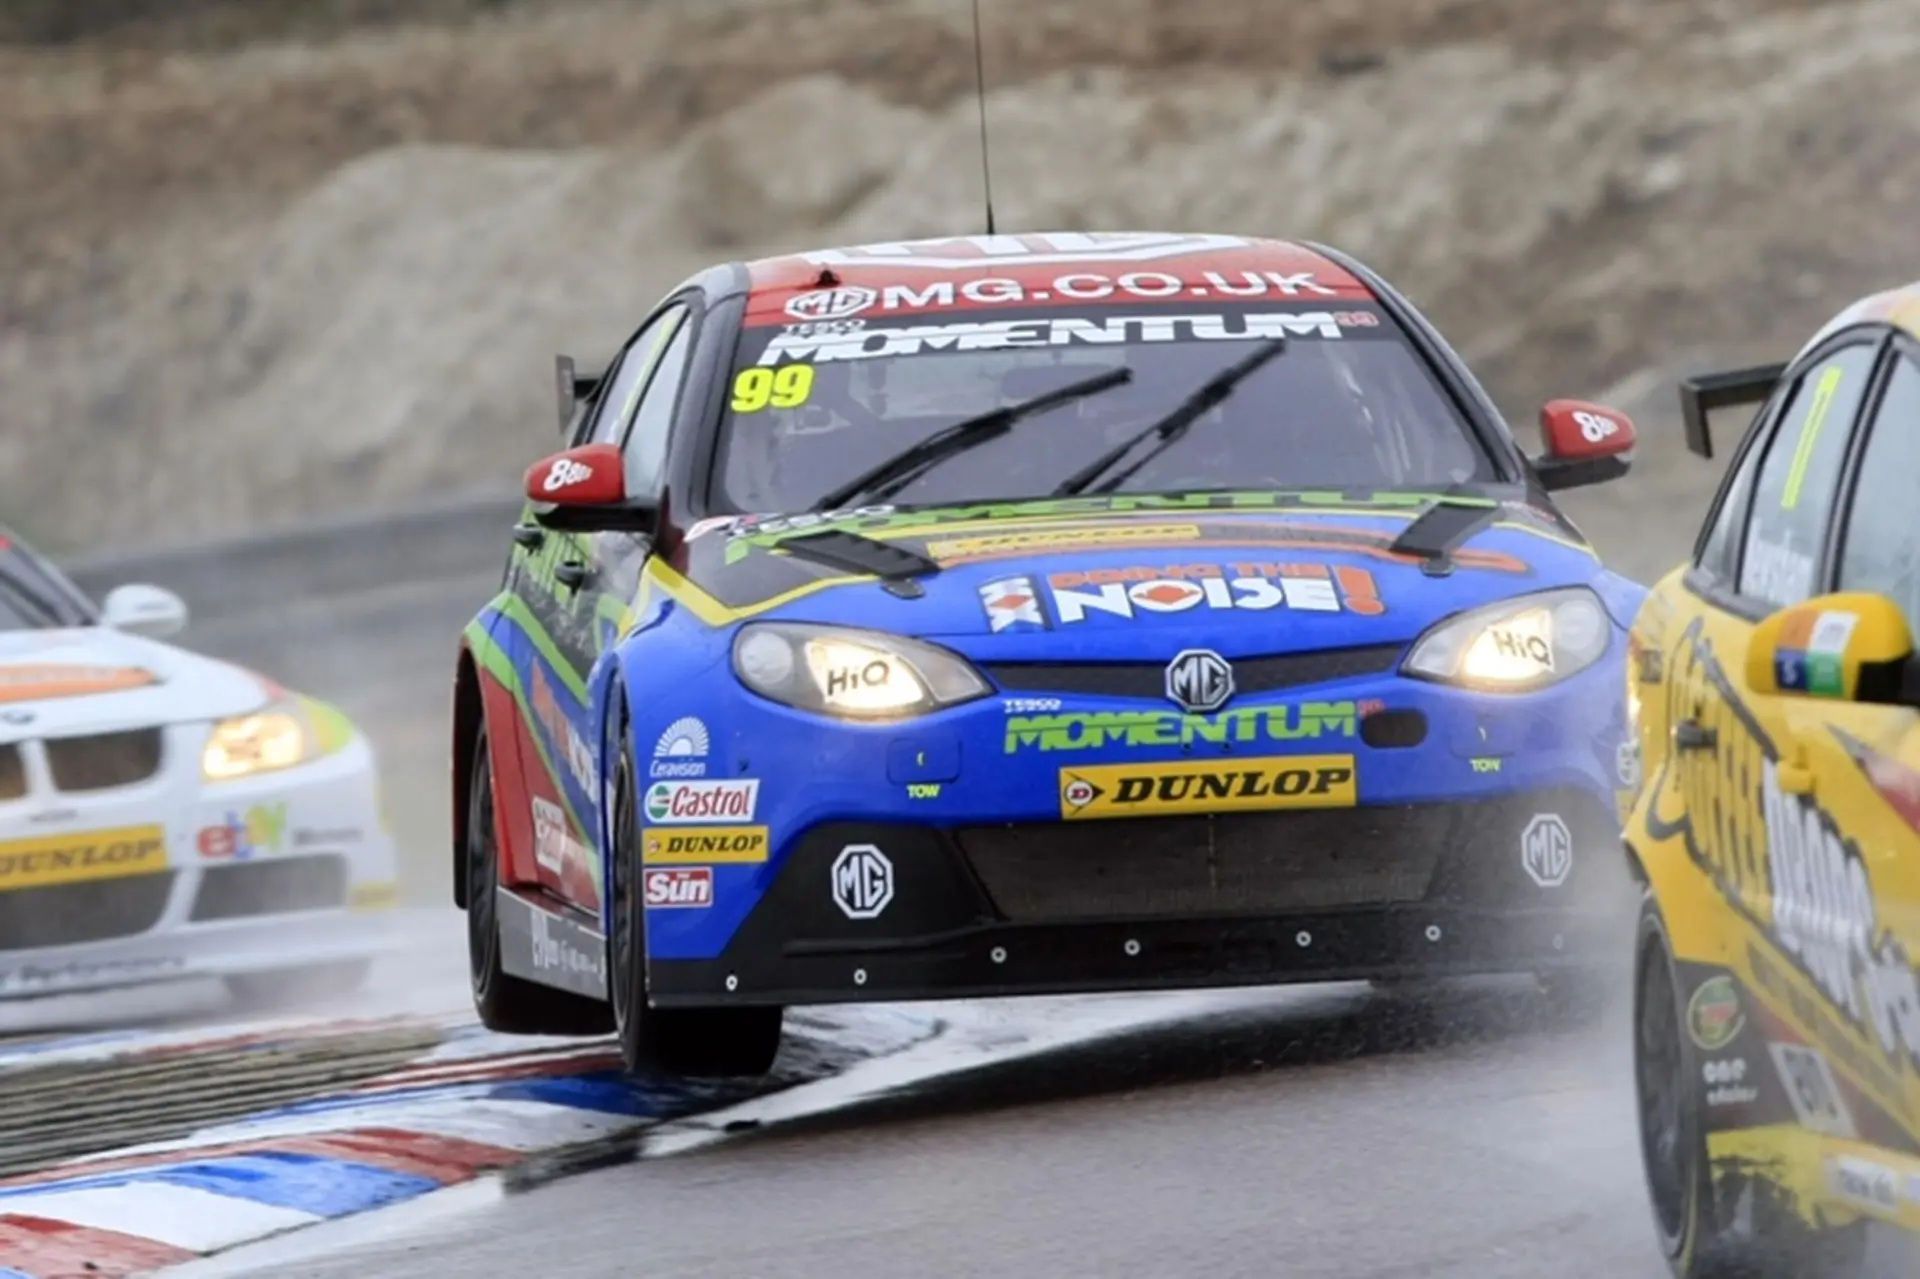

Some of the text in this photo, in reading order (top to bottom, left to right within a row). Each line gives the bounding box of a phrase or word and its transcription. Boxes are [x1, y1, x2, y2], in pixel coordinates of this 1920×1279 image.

[883, 271, 1338, 309] MG.CO.UK
[757, 311, 1342, 366] MOMENTUM
[731, 363, 814, 412] 99
[1494, 630, 1552, 666] HiQ
[827, 660, 890, 697] HiQ
[1173, 656, 1228, 703] MG
[1004, 700, 1356, 754] MOMENTUM
[1471, 758, 1502, 772] TOW
[671, 786, 751, 817] Castrol
[906, 784, 941, 799] TOW
[1111, 769, 1351, 803] DUNLOP
[667, 835, 763, 853] DUNLOP
[1528, 822, 1566, 878] MG
[646, 872, 708, 902] Sun
[838, 855, 884, 908] MG
